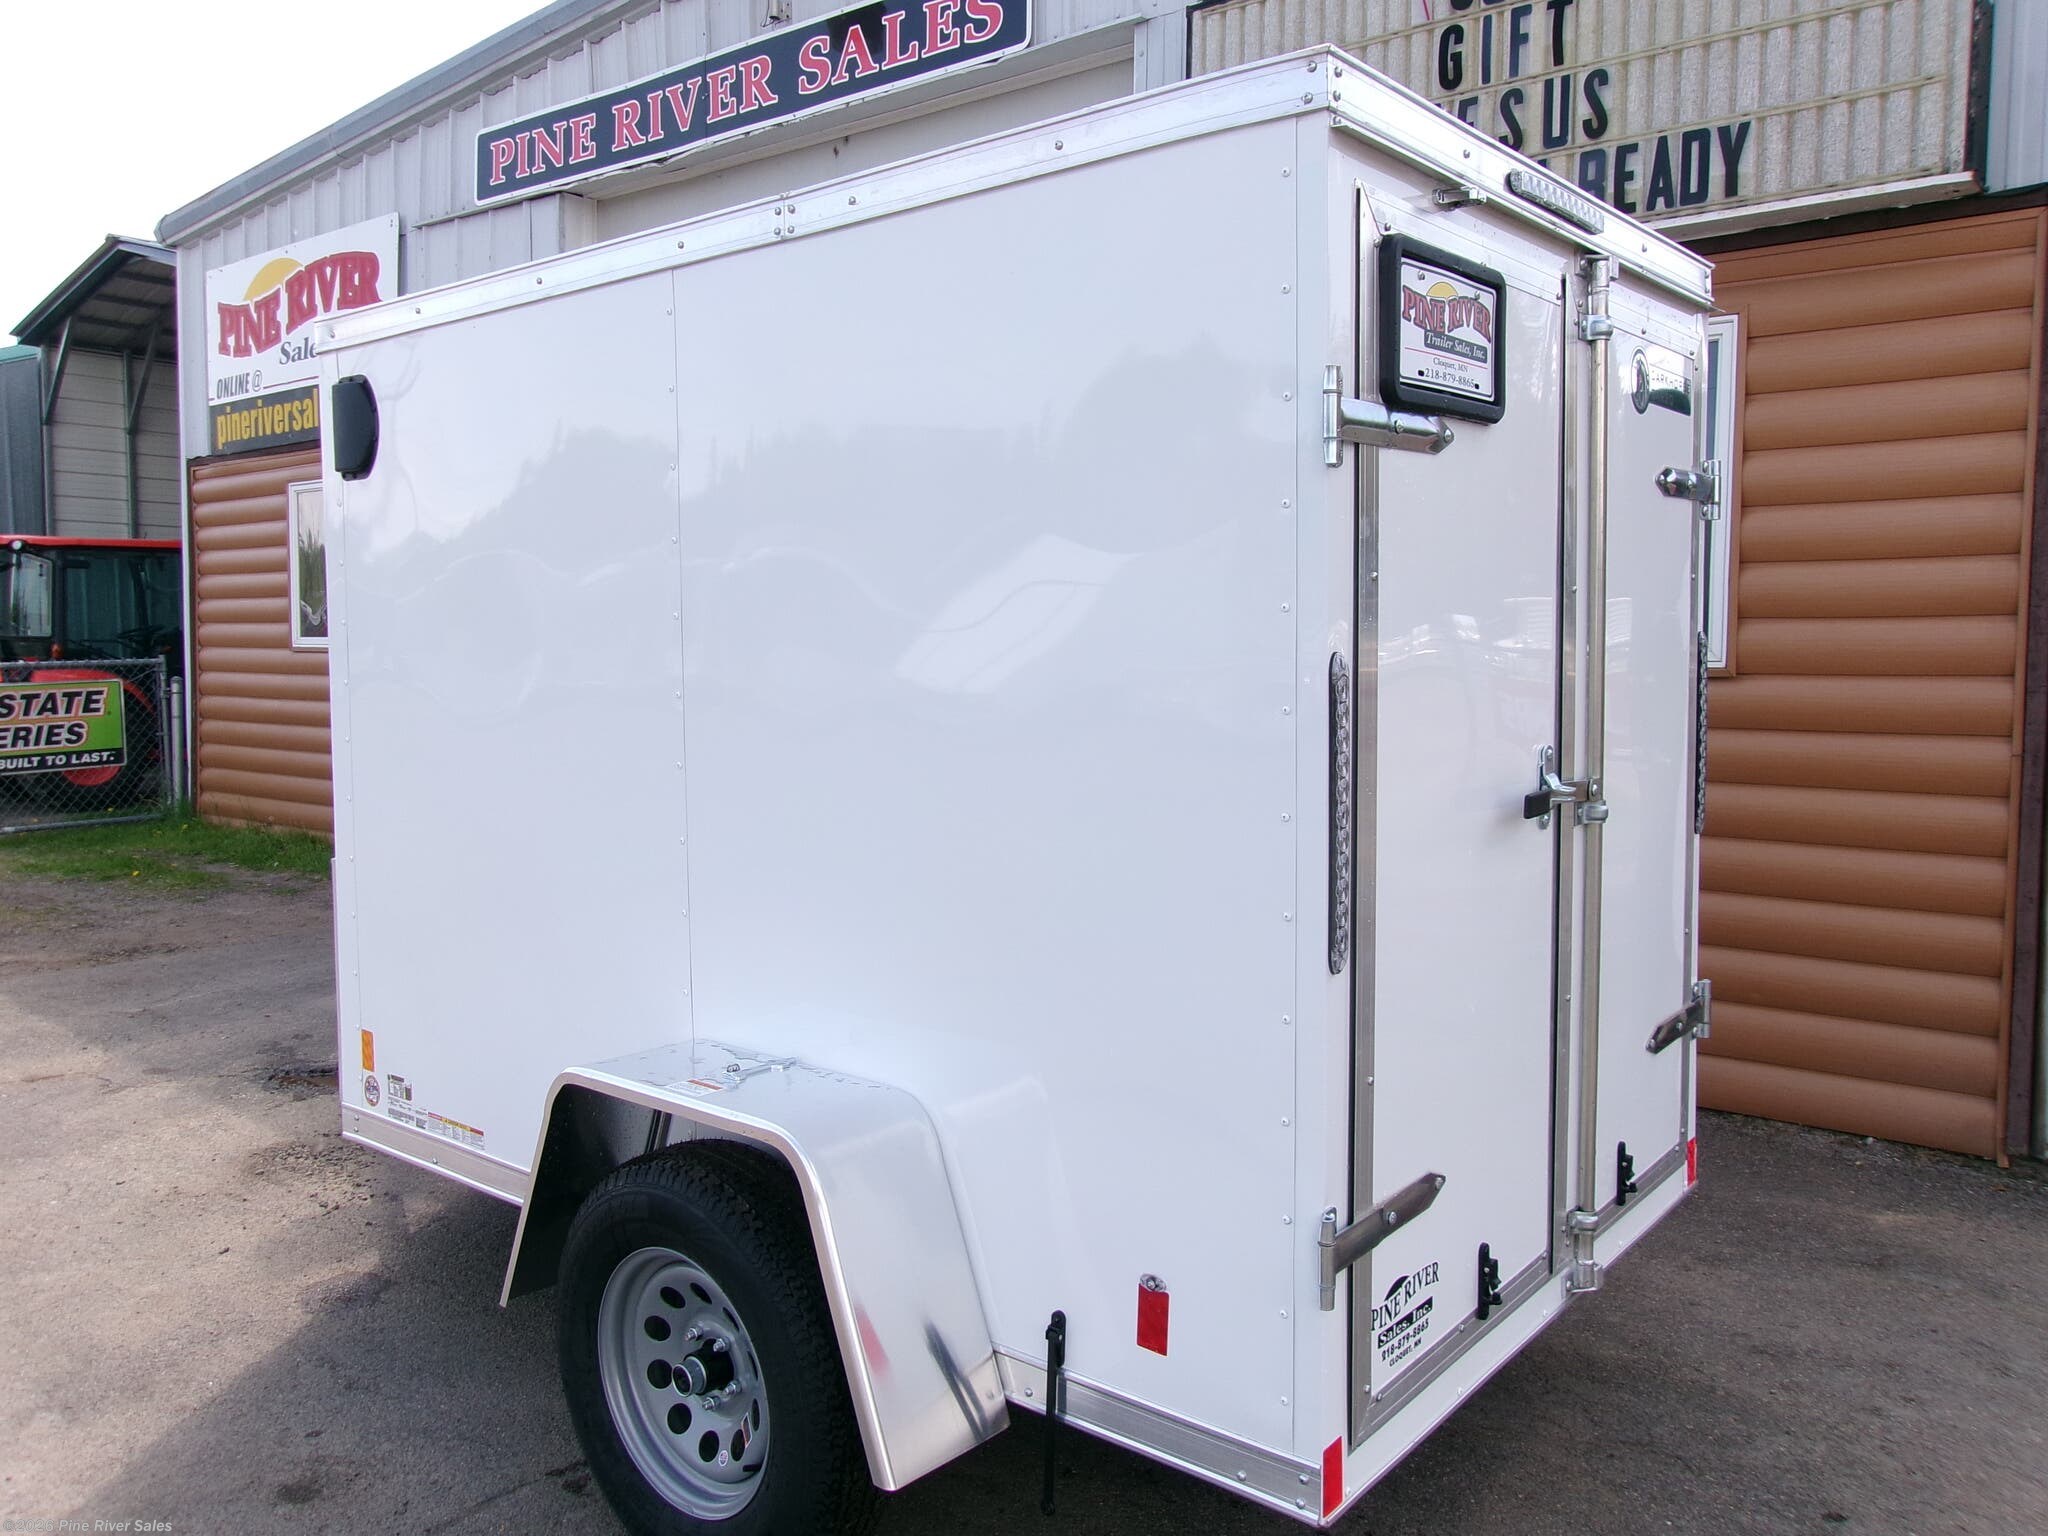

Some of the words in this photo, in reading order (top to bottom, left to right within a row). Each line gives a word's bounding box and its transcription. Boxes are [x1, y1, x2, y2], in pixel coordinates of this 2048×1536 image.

[1438, 0, 1574, 90] GIFT
[490, 113, 597, 186] PINE
[611, 55, 779, 153] RIVER
[798, 0, 1004, 95] SALES
[1435, 68, 1609, 151] SUS
[218, 288, 283, 358] PINE
[285, 251, 383, 336] RIVER
[1402, 284, 1446, 335] PINE
[1447, 296, 1492, 344] RIVER
[1426, 331, 1454, 349] Trailer
[216, 372, 251, 399] ONLINE
[252, 369, 263, 393] @
[1425, 368, 1475, 389] 218-879-8865
[46, 754, 67, 766] TO
[1371, 1291, 1402, 1331] PINE
[1403, 1261, 1440, 1306] RIVER
